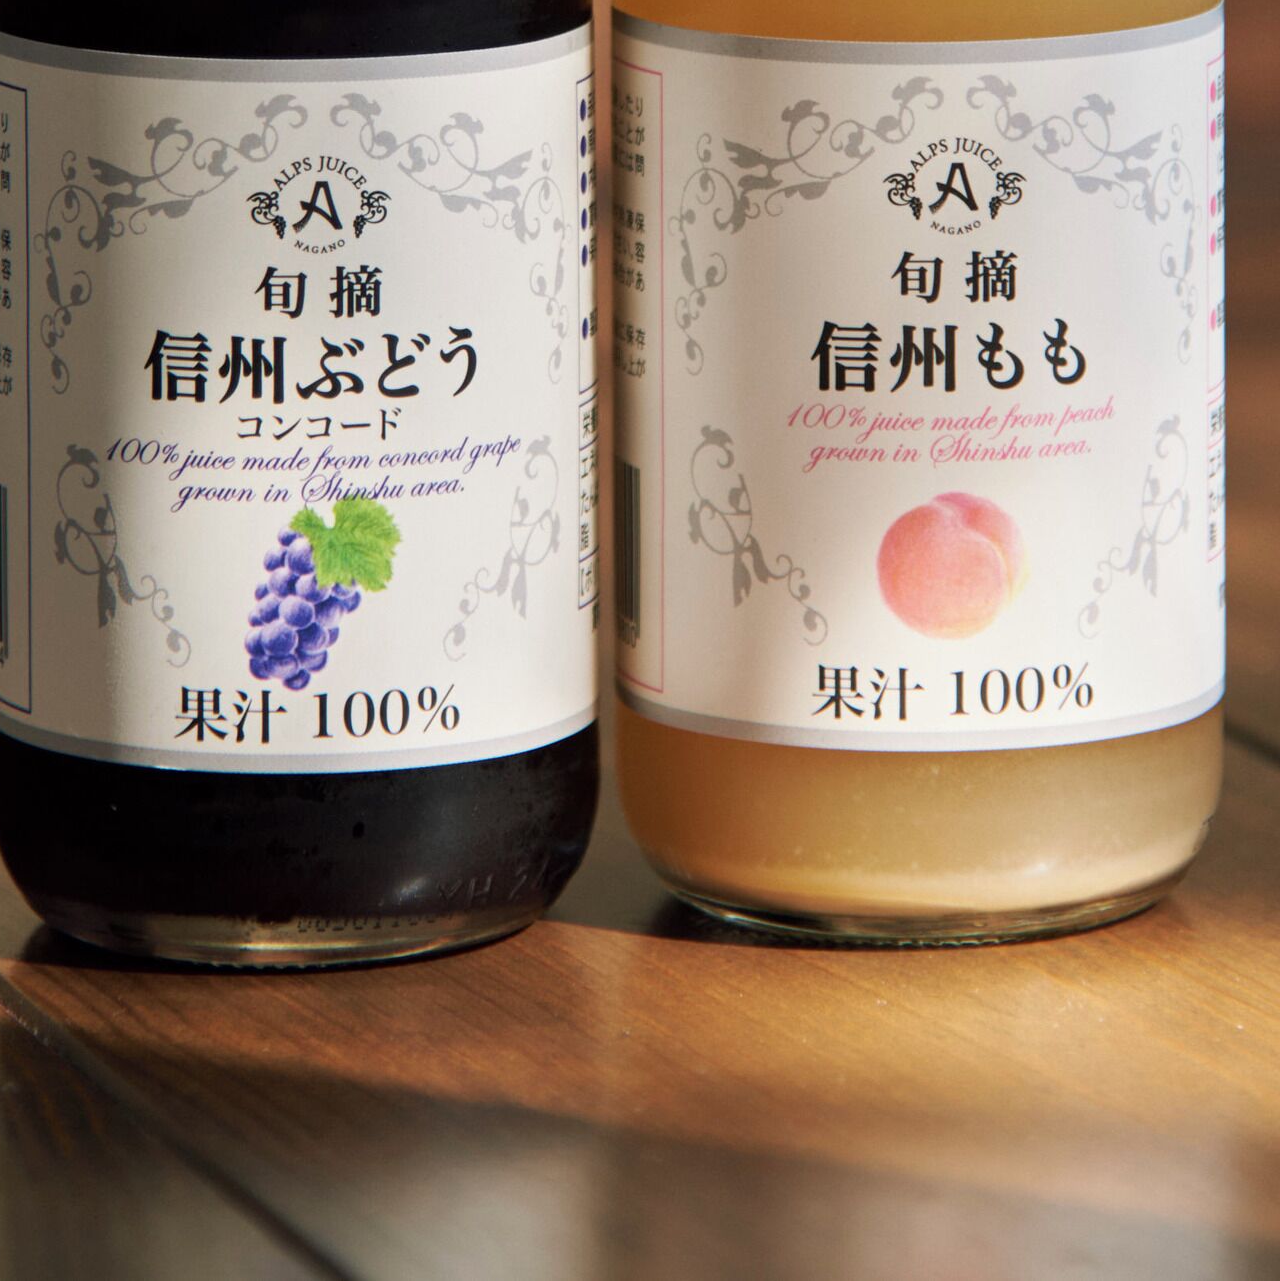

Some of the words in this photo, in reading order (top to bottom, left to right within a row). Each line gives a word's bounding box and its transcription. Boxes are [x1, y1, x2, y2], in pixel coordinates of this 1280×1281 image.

[273, 157, 313, 192] ALPS
[318, 155, 367, 190] JUICE
[910, 139, 948, 173] ALPS
[953, 137, 1003, 171] JUICE
[294, 239, 345, 254] NAGANO
[930, 220, 981, 235] NAGANO
[255, 265, 383, 318] 旬摘
[891, 250, 1018, 303] 旬摘
[144, 326, 477, 404] 信州ぶどう
[810, 318, 1087, 393] 信州もも
[237, 407, 402, 441] コンコード
[786, 403, 867, 429] 100%
[855, 412, 924, 444] juice
[930, 405, 997, 431] made
[988, 402, 1056, 440] from
[1053, 395, 1116, 437] peach
[106, 437, 179, 465] 100%
[169, 449, 235, 481] juice
[242, 447, 310, 471] made
[300, 446, 372, 481] from
[378, 436, 468, 468] concord
[462, 435, 521, 474] grape
[802, 443, 887, 473] grown
[892, 443, 920, 462] in
[929, 431, 1033, 468] Shinshu
[1037, 437, 1093, 457] area.
[171, 484, 255, 513] grown
[264, 484, 291, 503] in
[301, 473, 405, 504] Shinshu
[410, 476, 465, 496] area.
[174, 686, 288, 744] 果汁
[312, 683, 461, 739] 100%
[811, 663, 925, 721] 果汁
[950, 662, 1094, 716] 100%
